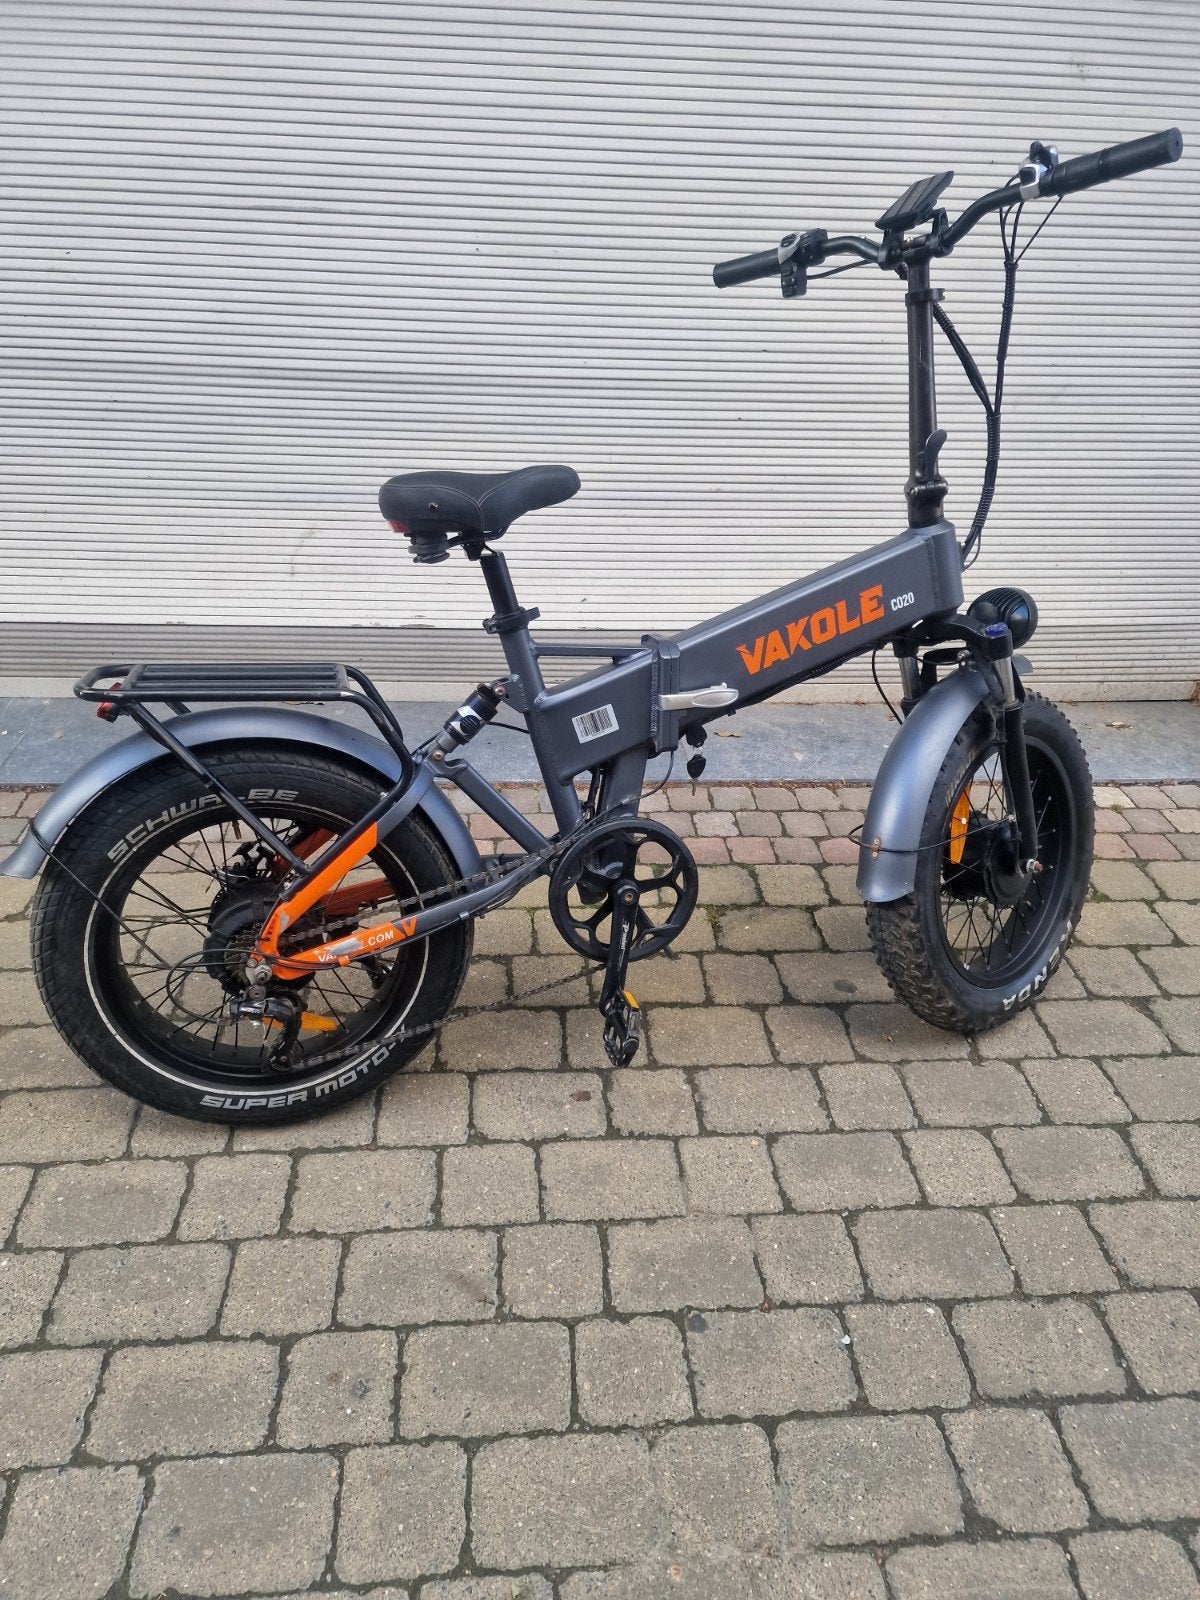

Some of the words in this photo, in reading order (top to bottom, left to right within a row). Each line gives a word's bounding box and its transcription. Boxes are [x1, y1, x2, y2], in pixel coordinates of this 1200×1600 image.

[736, 584, 885, 675] VAKOLE
[107, 788, 299, 863] SCHWABE
[317, 930, 394, 963] VAE.COM
[200, 1091, 307, 1110] SUPER
